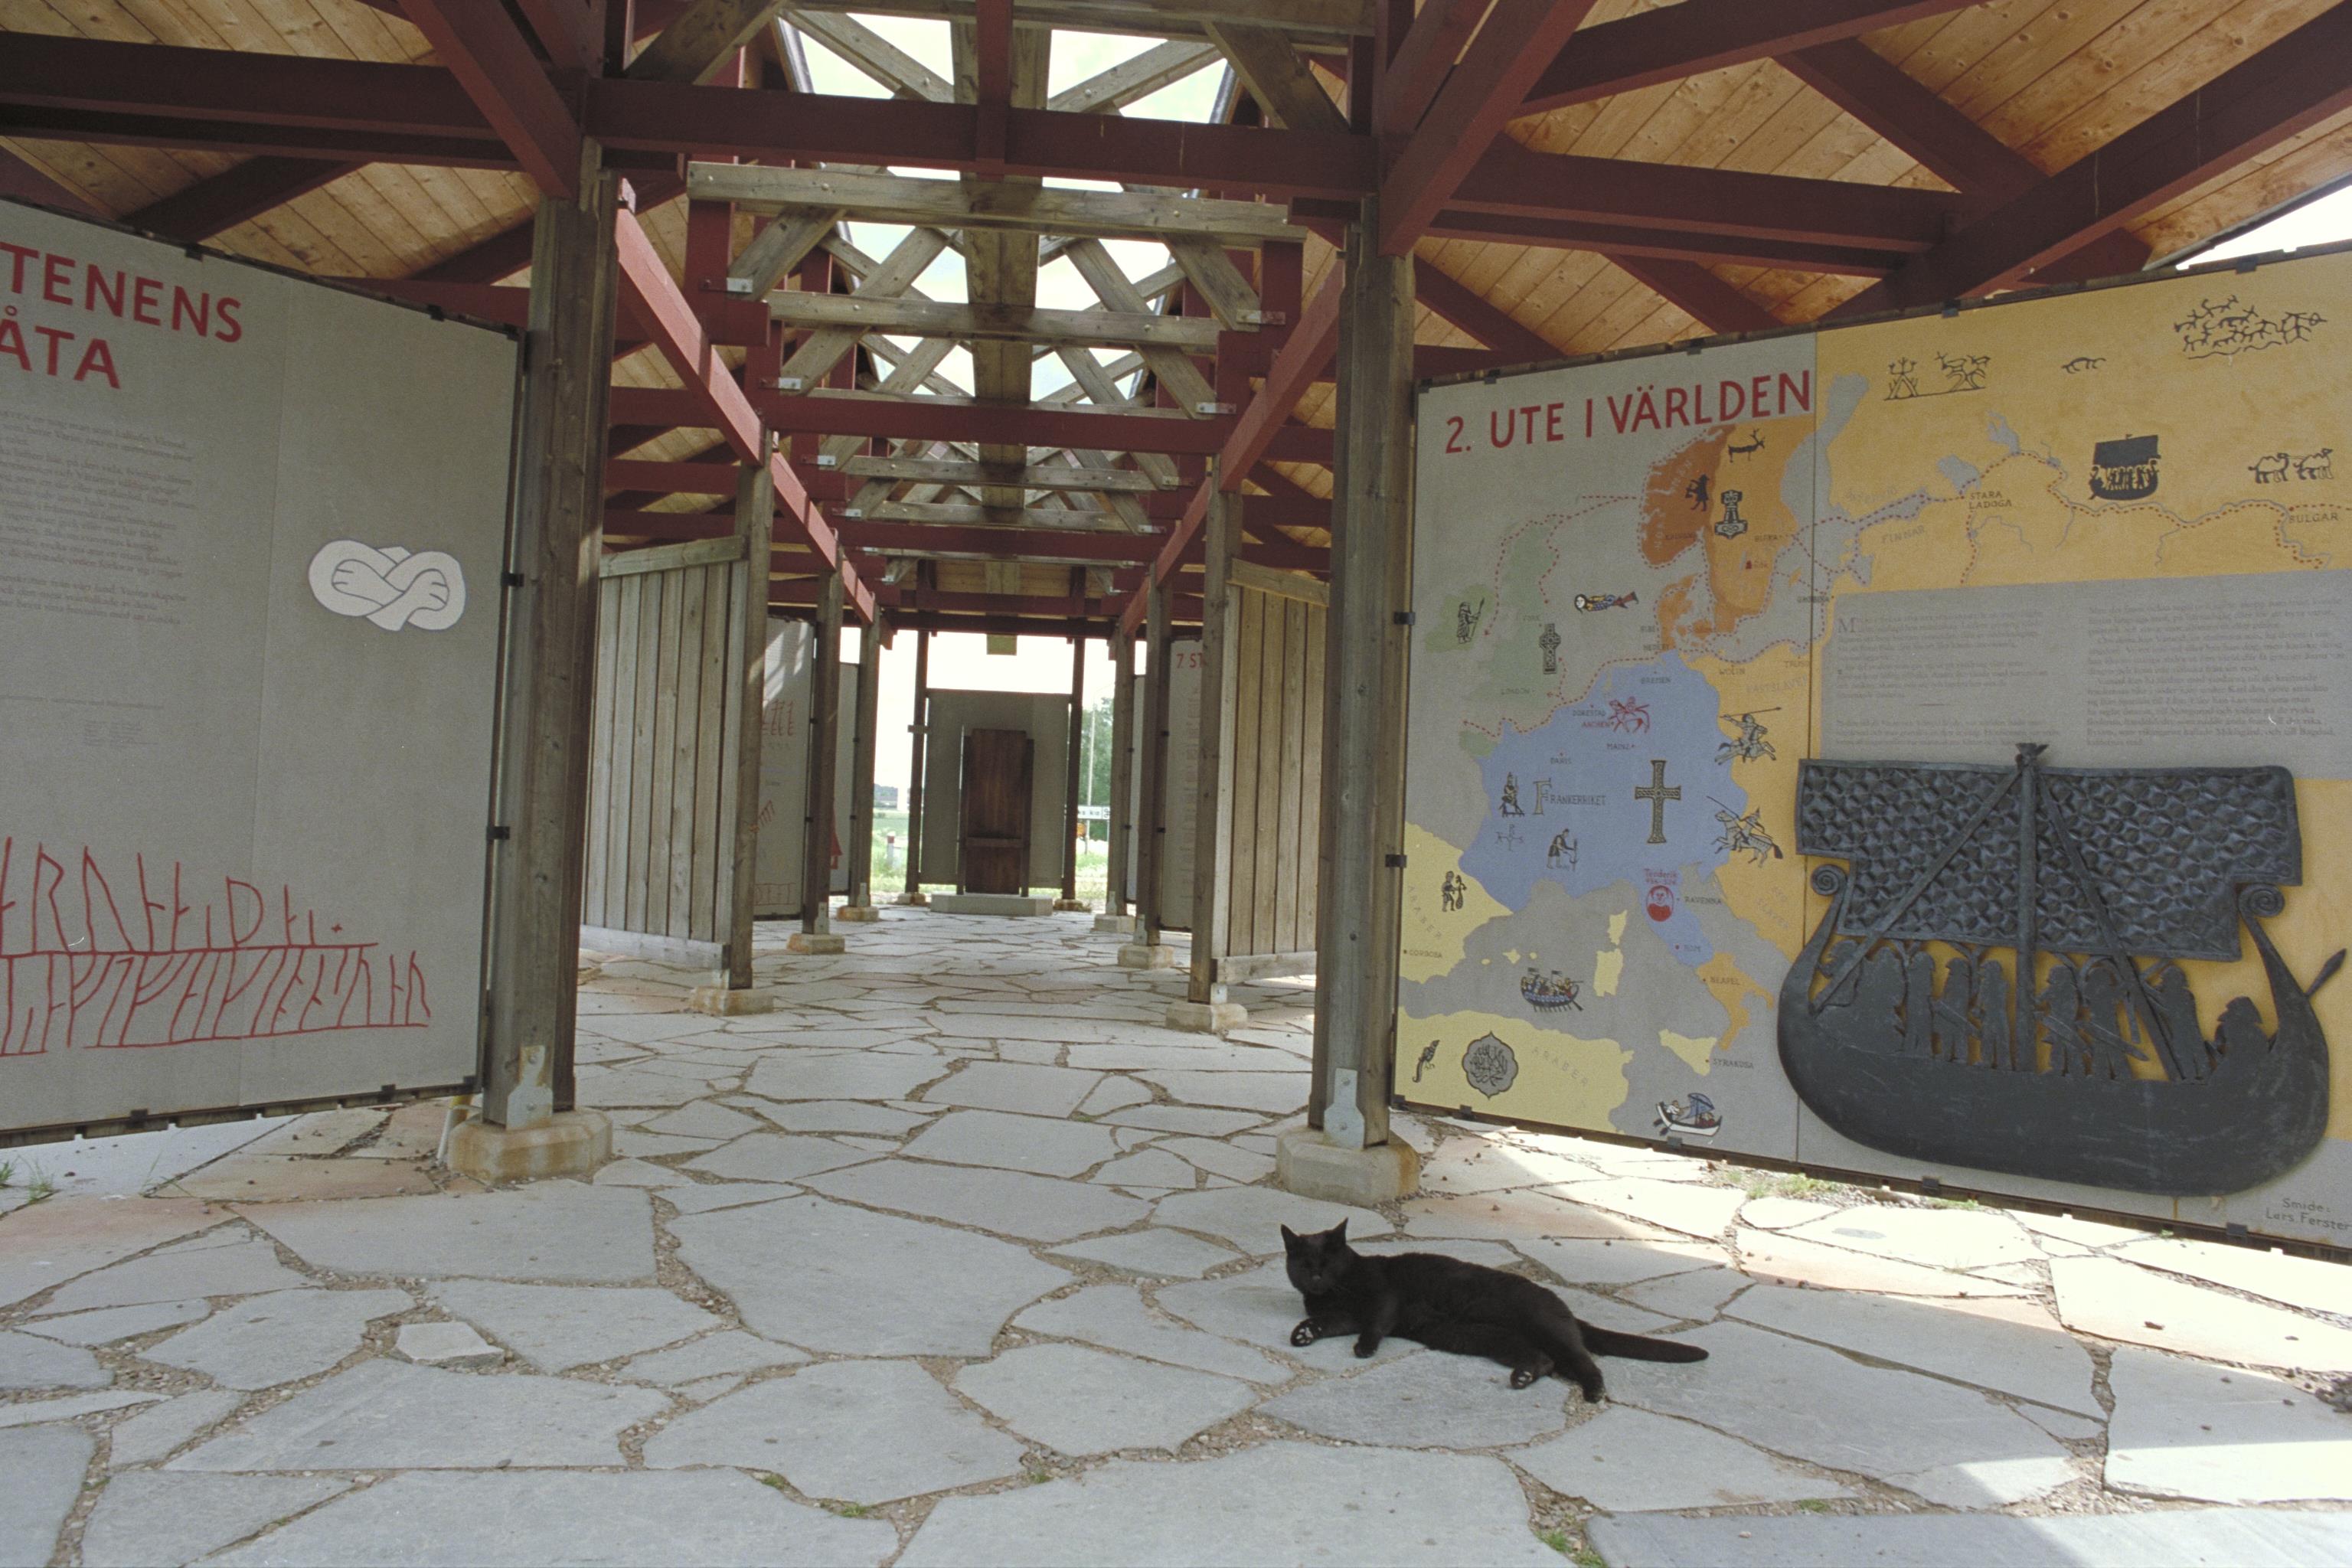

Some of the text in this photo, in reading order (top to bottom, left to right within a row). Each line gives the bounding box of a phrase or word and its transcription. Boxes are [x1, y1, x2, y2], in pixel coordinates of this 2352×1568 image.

[1445, 370, 1811, 454] 2. UTE I VÄRLDEN
[1969, 491, 2003, 500] STARA
[1968, 498, 2012, 510] LADOGA
[2288, 511, 2340, 524] BULGAR
[1532, 778, 1606, 816] FRANKERRIKET
[1684, 896, 1722, 905] RAVENNA
[2265, 1207, 2295, 1222] Lars
